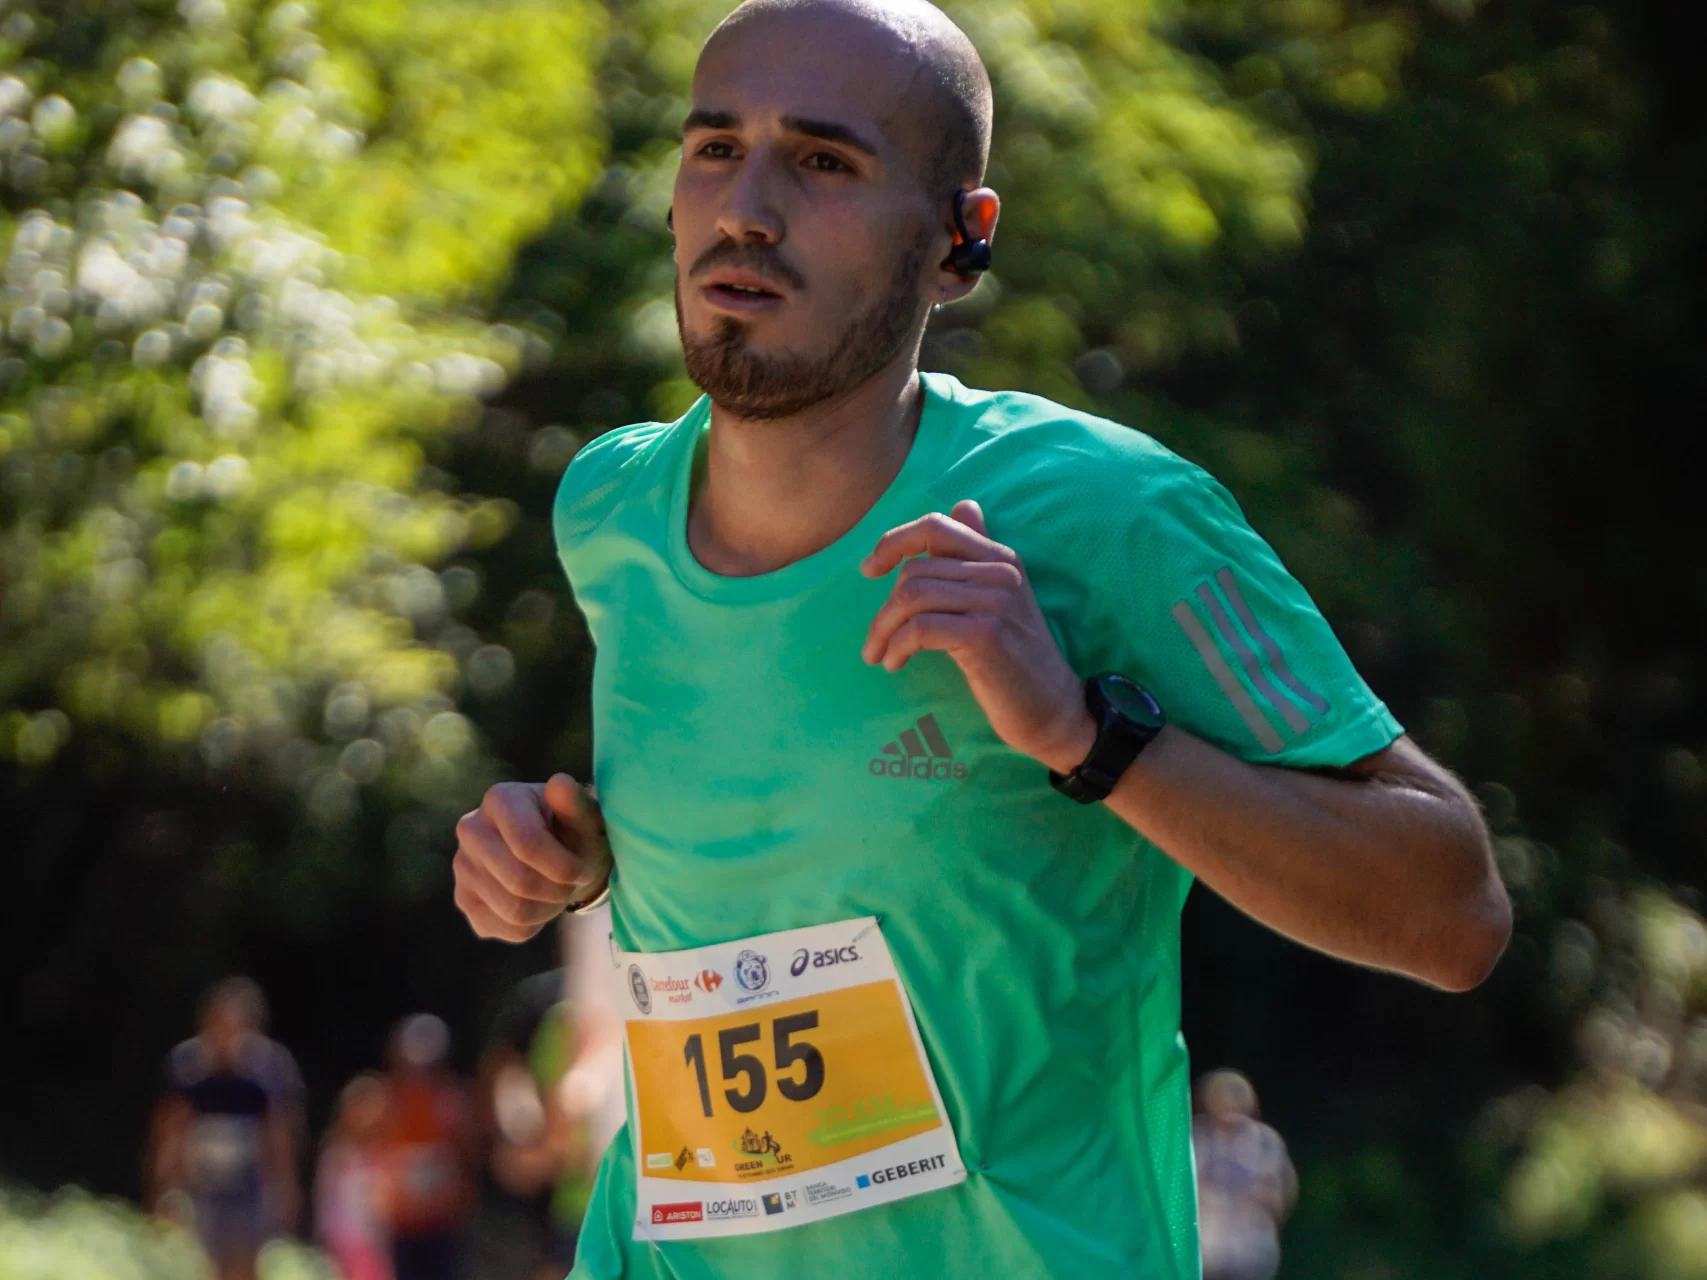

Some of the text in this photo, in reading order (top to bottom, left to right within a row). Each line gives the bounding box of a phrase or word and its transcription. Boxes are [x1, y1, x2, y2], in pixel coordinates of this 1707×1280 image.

[869, 755, 968, 780] adidas
[813, 945, 859, 969] asics
[649, 976, 690, 992] Carrefour
[684, 1009, 826, 1118] 155
[734, 1160, 763, 1172] GREEN
[871, 1154, 945, 1184] GEBERIT
[666, 1210, 701, 1221] ARISTON
[707, 1198, 754, 1214] LOCAUTO
